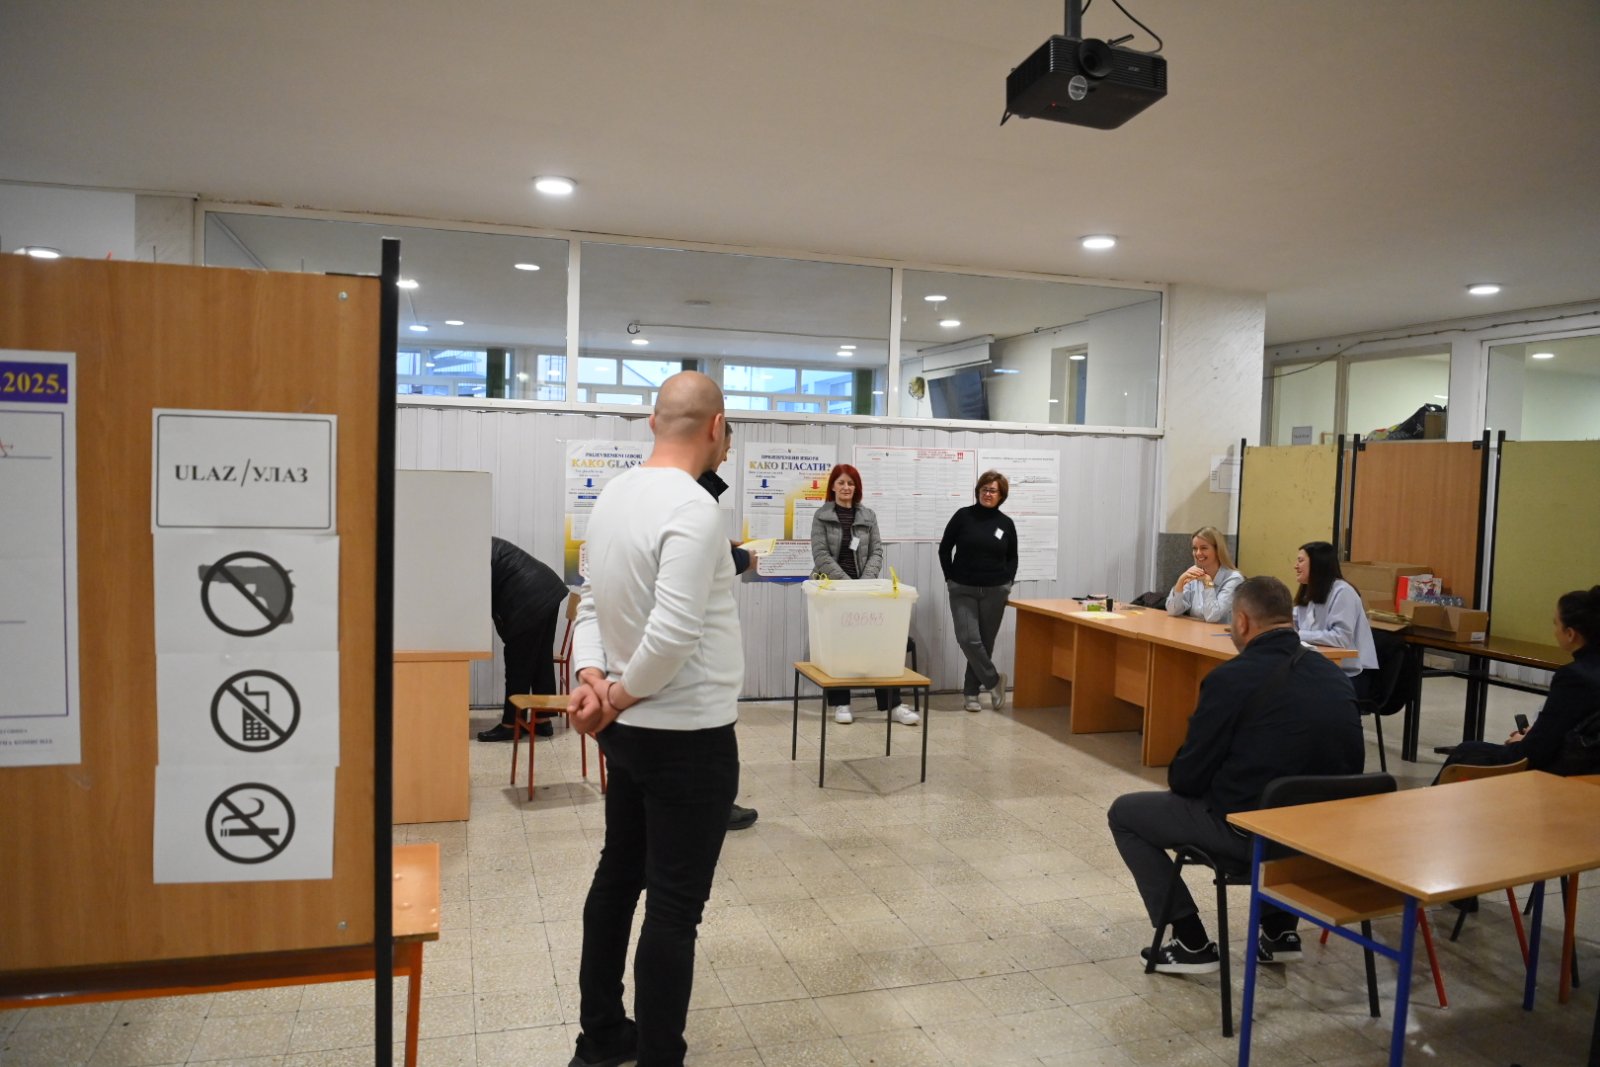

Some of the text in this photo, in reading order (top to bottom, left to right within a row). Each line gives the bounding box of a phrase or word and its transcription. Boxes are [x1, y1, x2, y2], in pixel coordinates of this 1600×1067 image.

[0, 371, 66, 395] 2025.
[572, 459, 605, 468] KAKO
[749, 461, 832, 471] КАКО ГЛАСАТИ?
[174, 458, 309, 487] ULAZ/УЛАЗ
